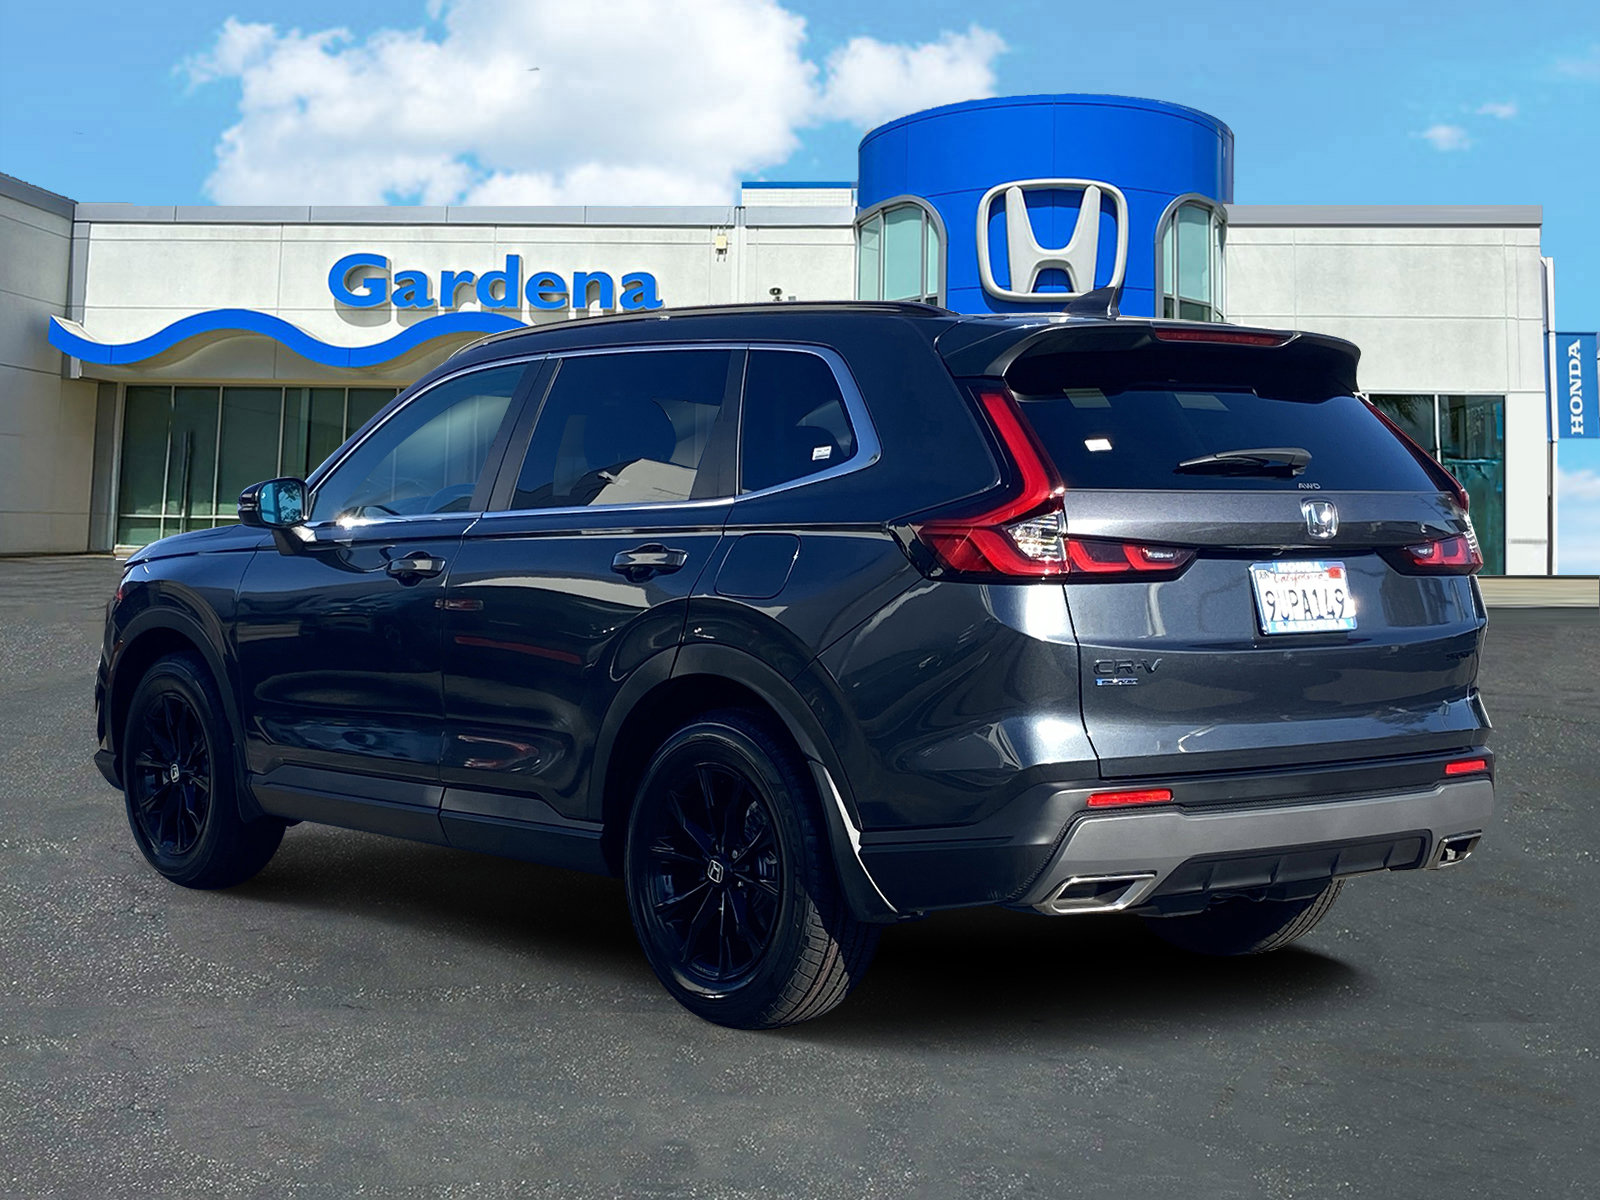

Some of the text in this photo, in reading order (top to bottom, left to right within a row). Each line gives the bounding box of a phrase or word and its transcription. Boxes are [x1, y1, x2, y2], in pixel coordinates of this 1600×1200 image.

[328, 252, 664, 310] Gardena
[1568, 339, 1584, 435] HONDA
[1298, 482, 1321, 490] AWD
[1093, 658, 1163, 675] CR-V
